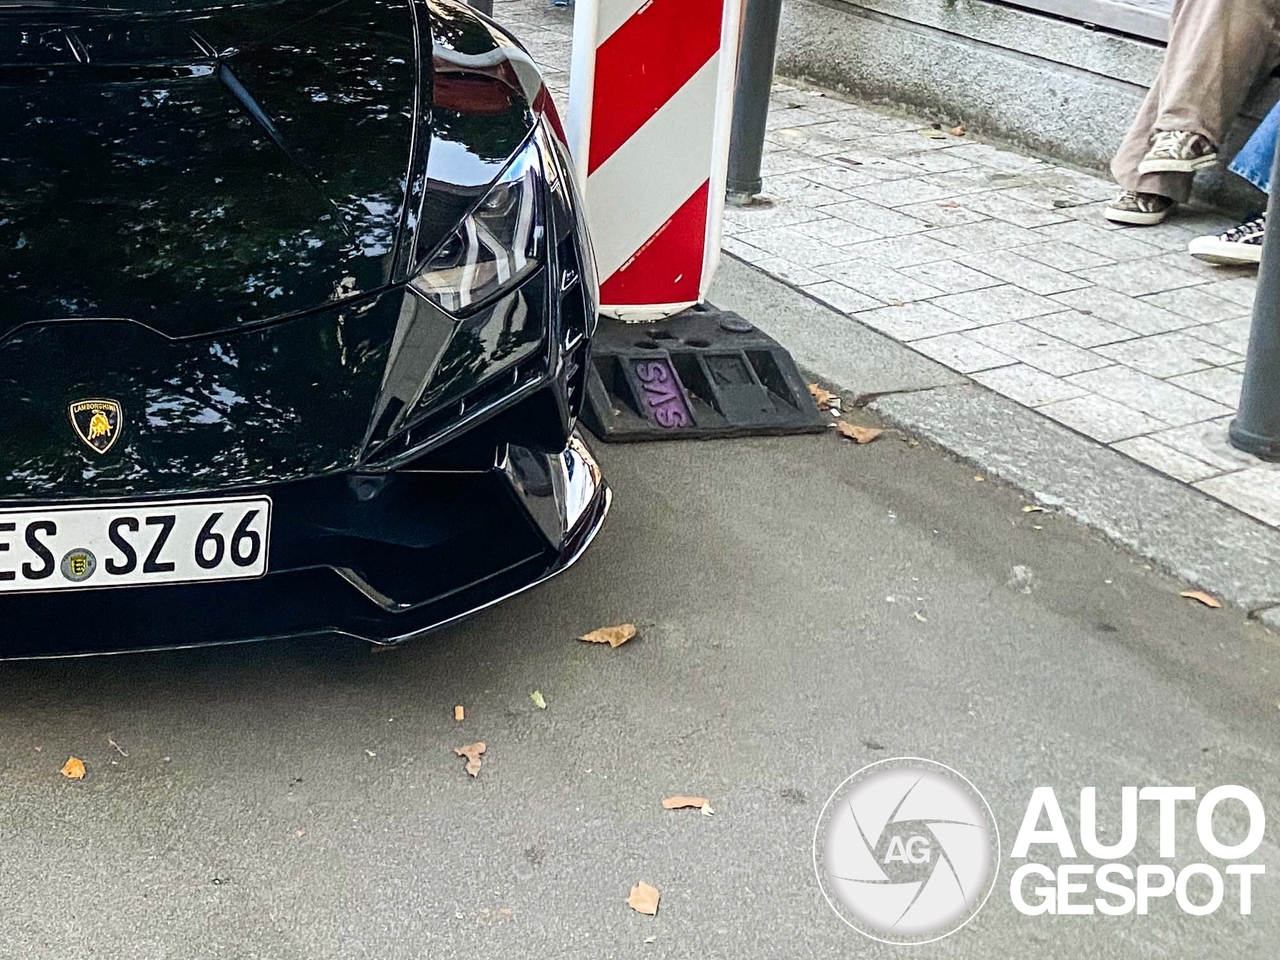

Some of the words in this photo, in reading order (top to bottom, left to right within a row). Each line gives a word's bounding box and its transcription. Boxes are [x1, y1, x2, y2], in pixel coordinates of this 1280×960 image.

[73, 403, 117, 413] LAMBORGHINI
[105, 514, 176, 575] SZ
[195, 509, 261, 570] 66
